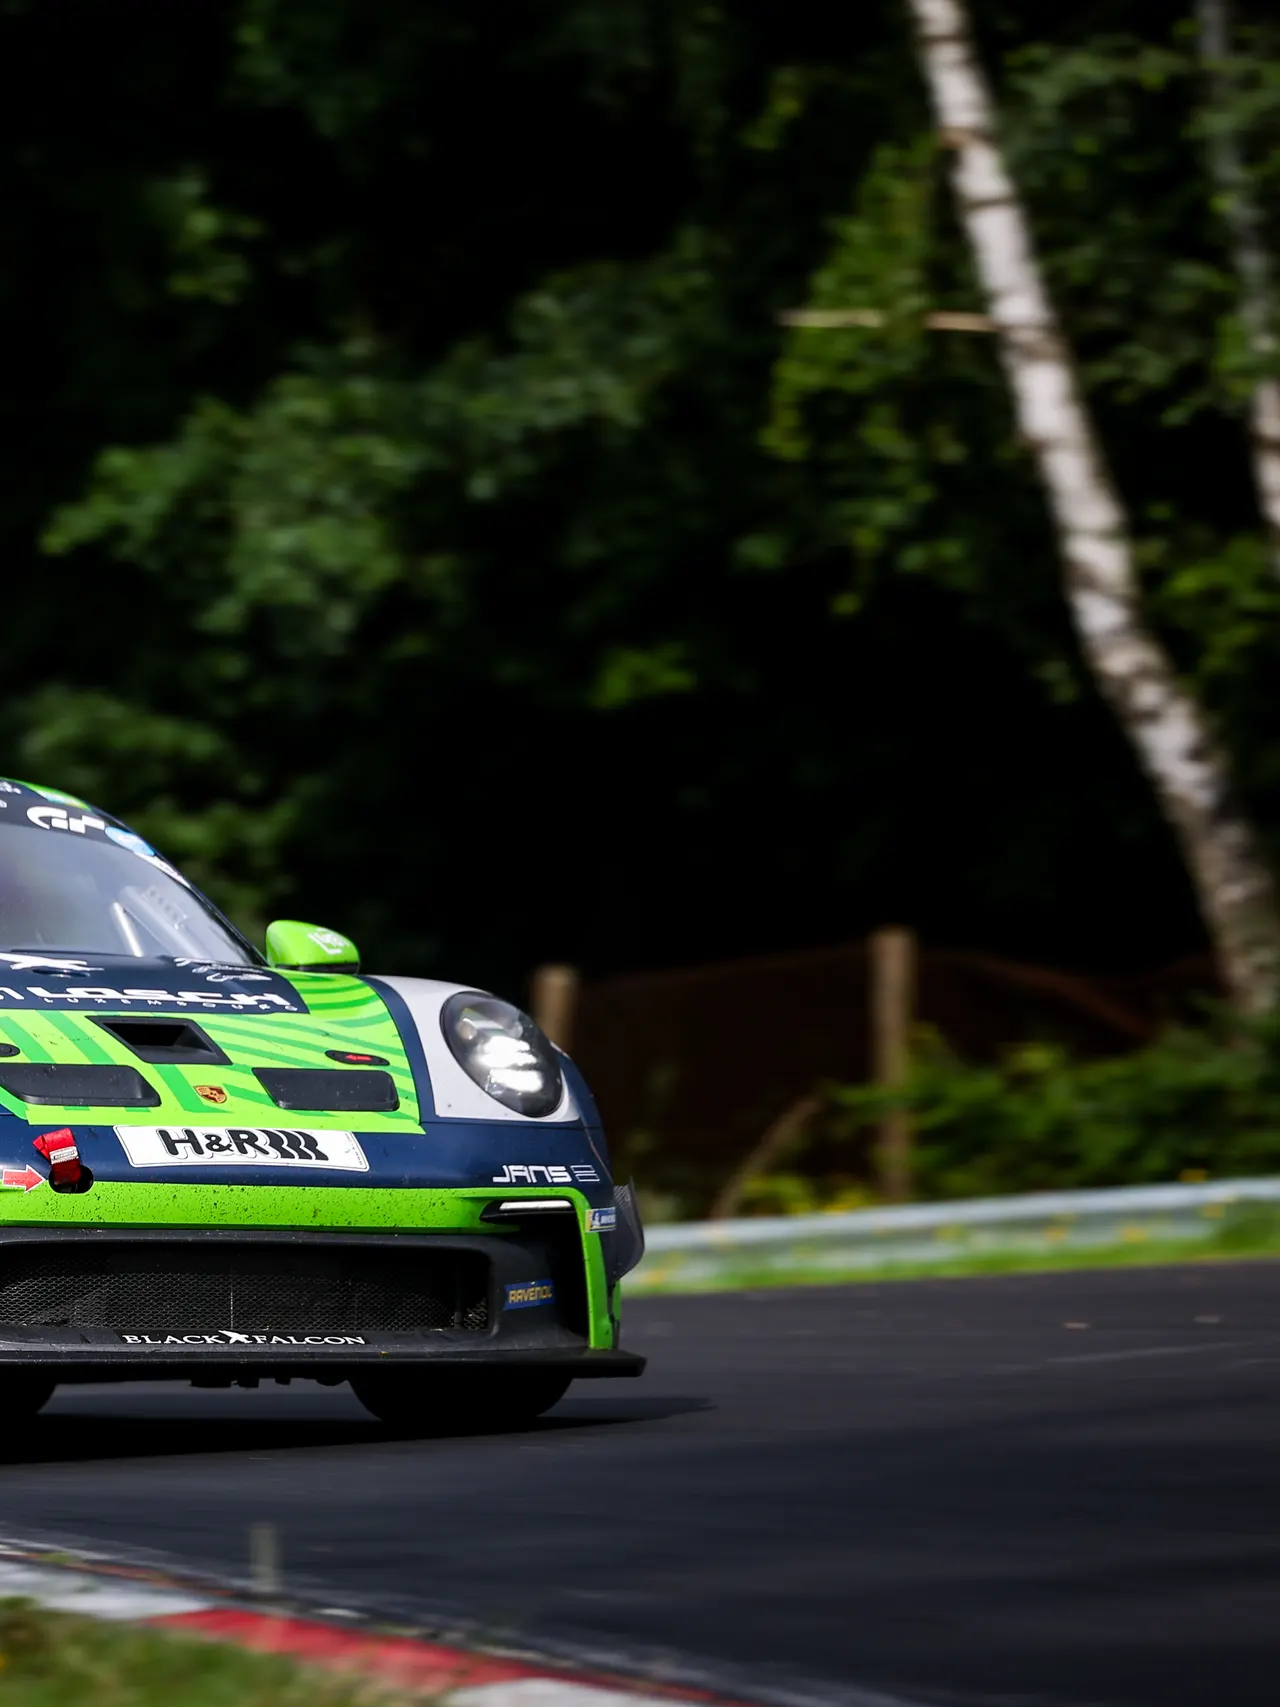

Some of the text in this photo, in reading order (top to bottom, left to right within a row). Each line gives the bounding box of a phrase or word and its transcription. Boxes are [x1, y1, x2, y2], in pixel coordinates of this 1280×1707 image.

[27, 986, 291, 1006] LOSCH
[492, 1165, 572, 1183] JANS
[508, 1286, 552, 1304] RAVENOL
[122, 1334, 366, 1346] BLACK FALCON
